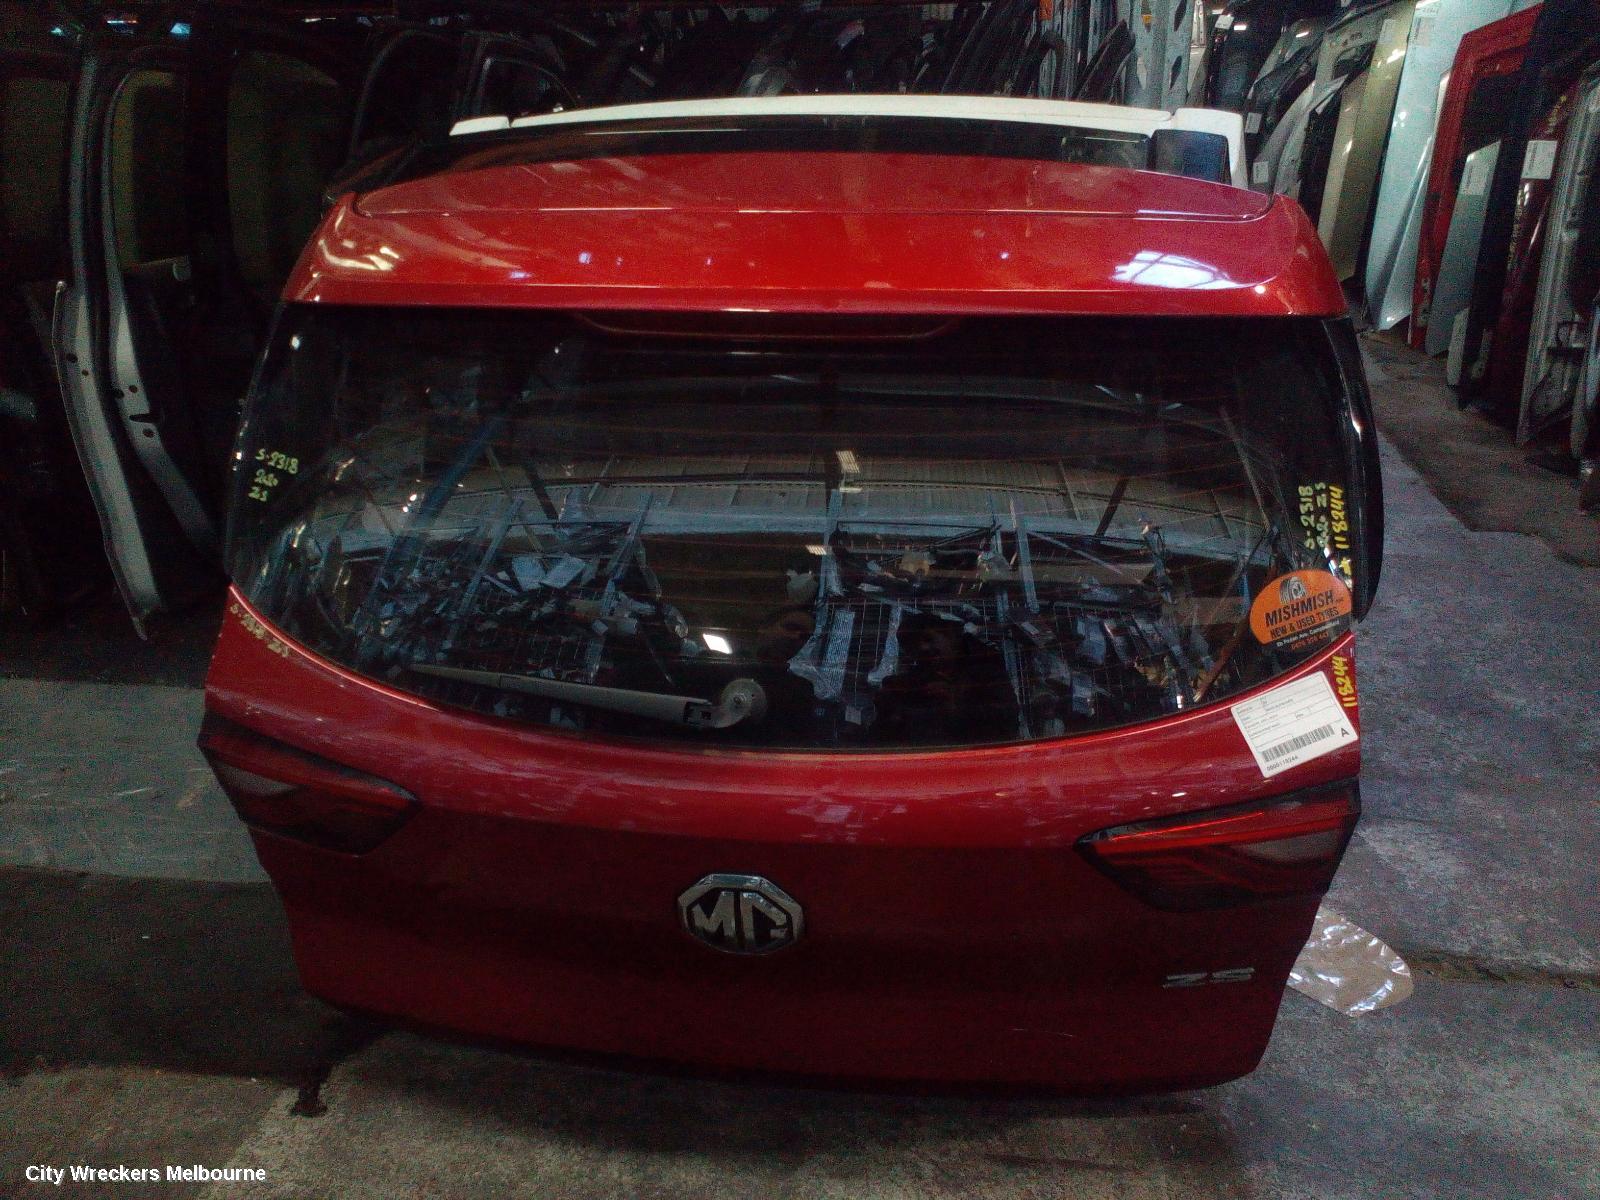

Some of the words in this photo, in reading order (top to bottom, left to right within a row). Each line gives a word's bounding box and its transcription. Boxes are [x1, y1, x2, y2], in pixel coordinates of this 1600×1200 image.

[1328, 485, 1350, 550] 118244
[1264, 589, 1334, 628] MISHMISH
[1331, 655, 1358, 708] 118244
[1340, 727, 1350, 738] A
[690, 889, 789, 947] MG
